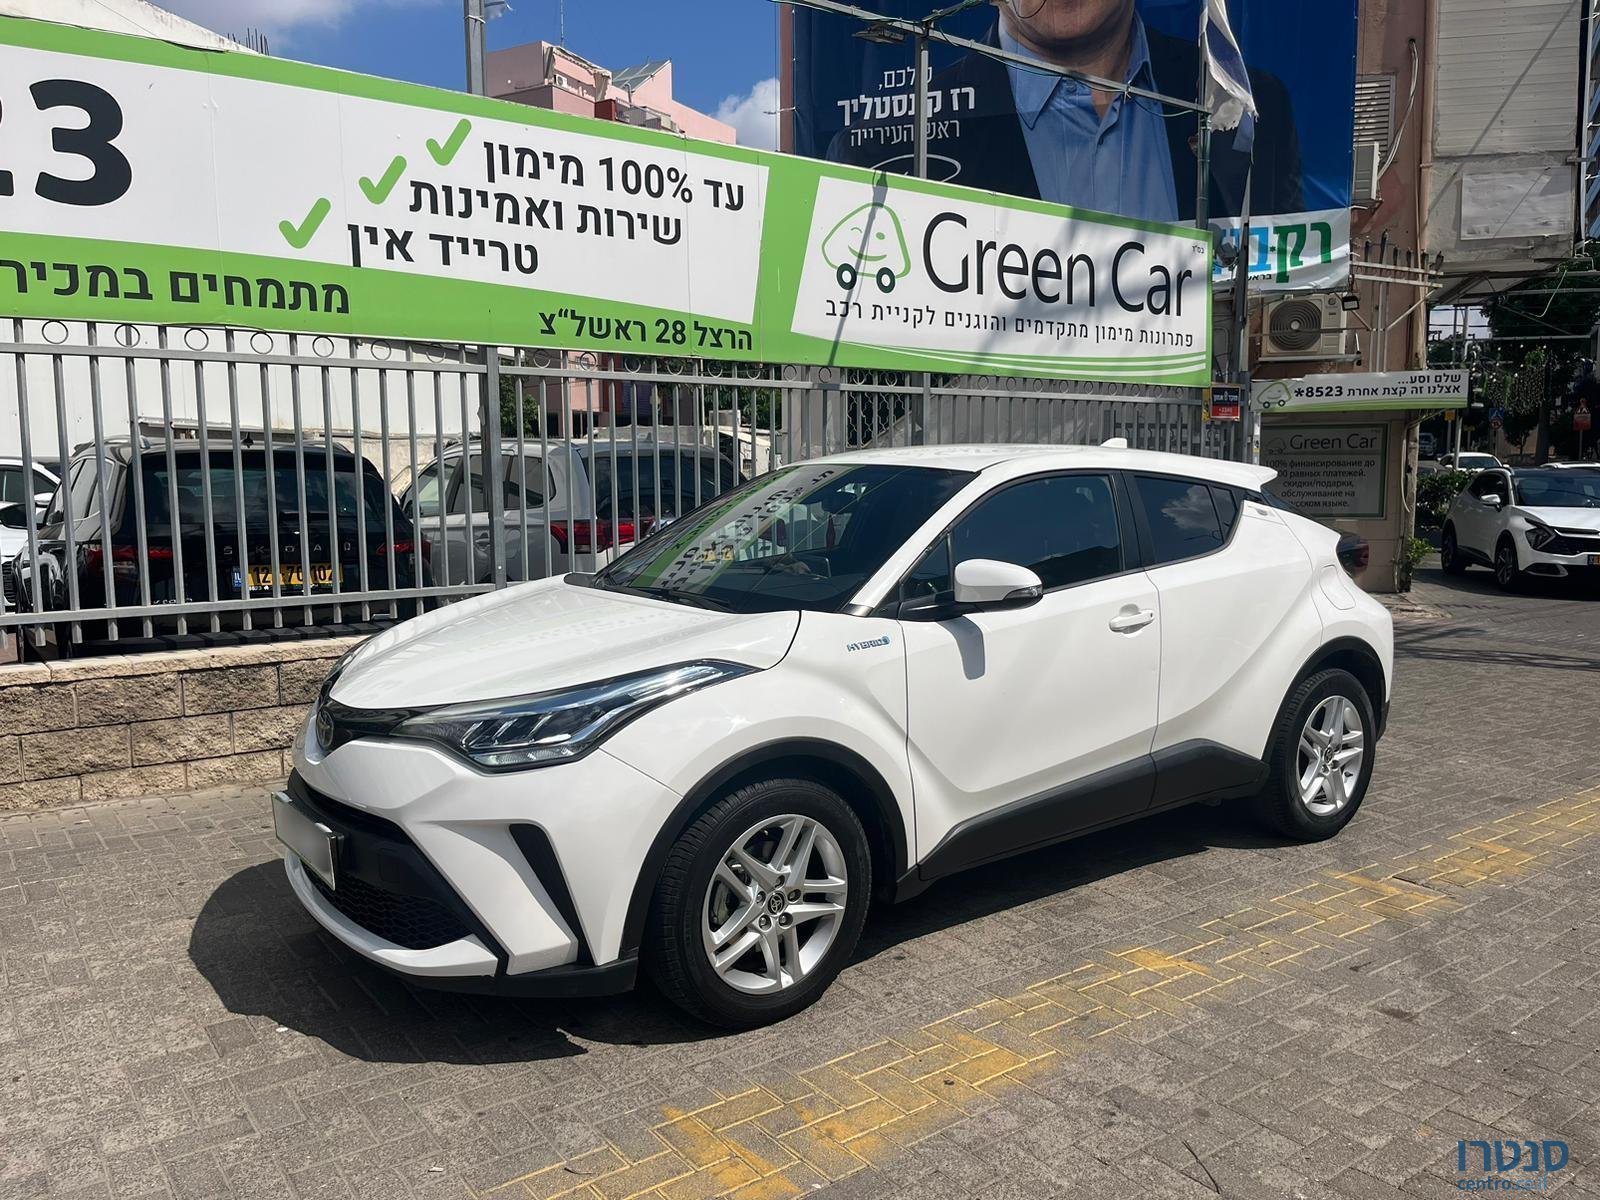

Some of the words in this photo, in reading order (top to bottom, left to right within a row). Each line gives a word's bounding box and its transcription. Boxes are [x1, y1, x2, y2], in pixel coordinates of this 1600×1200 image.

[837, 91, 943, 126] קנסטליך
[949, 86, 976, 111] רז
[0, 78, 132, 206] 3
[850, 124, 914, 147] העירייה
[483, 141, 584, 187] מימון
[598, 157, 693, 203] 100%
[409, 180, 564, 230] ואמינות
[703, 178, 744, 211] עד
[576, 204, 681, 245] שירות
[347, 223, 414, 267] אין
[429, 233, 538, 274] טרייד
[1272, 221, 1332, 283] רק
[922, 211, 1095, 308] Green
[1111, 241, 1192, 317] Car
[169, 270, 350, 314] מתמחים
[825, 298, 863, 320] רכב
[871, 302, 936, 329] לקניית
[655, 318, 687, 345] 28
[945, 311, 1007, 332] והוגנים
[1015, 316, 1089, 339] מתקדמים
[693, 320, 752, 350] הרצל
[1095, 323, 1133, 345] מימון
[1139, 328, 1194, 348] פתרונות
[1410, 386, 1425, 394] זה
[1427, 383, 1461, 394] אצלנו
[1434, 373, 1461, 383] שלם
[1346, 387, 1379, 396] אחרת
[1382, 386, 1407, 397] קצת
[1290, 434, 1342, 450] Green
[1346, 433, 1377, 449] Car
[1289, 459, 1362, 469] финансирование
[1363, 460, 1375, 469] до
[1289, 470, 1321, 479] равных
[1281, 489, 1343, 499] обслуживание
[1290, 500, 1320, 508] усском
